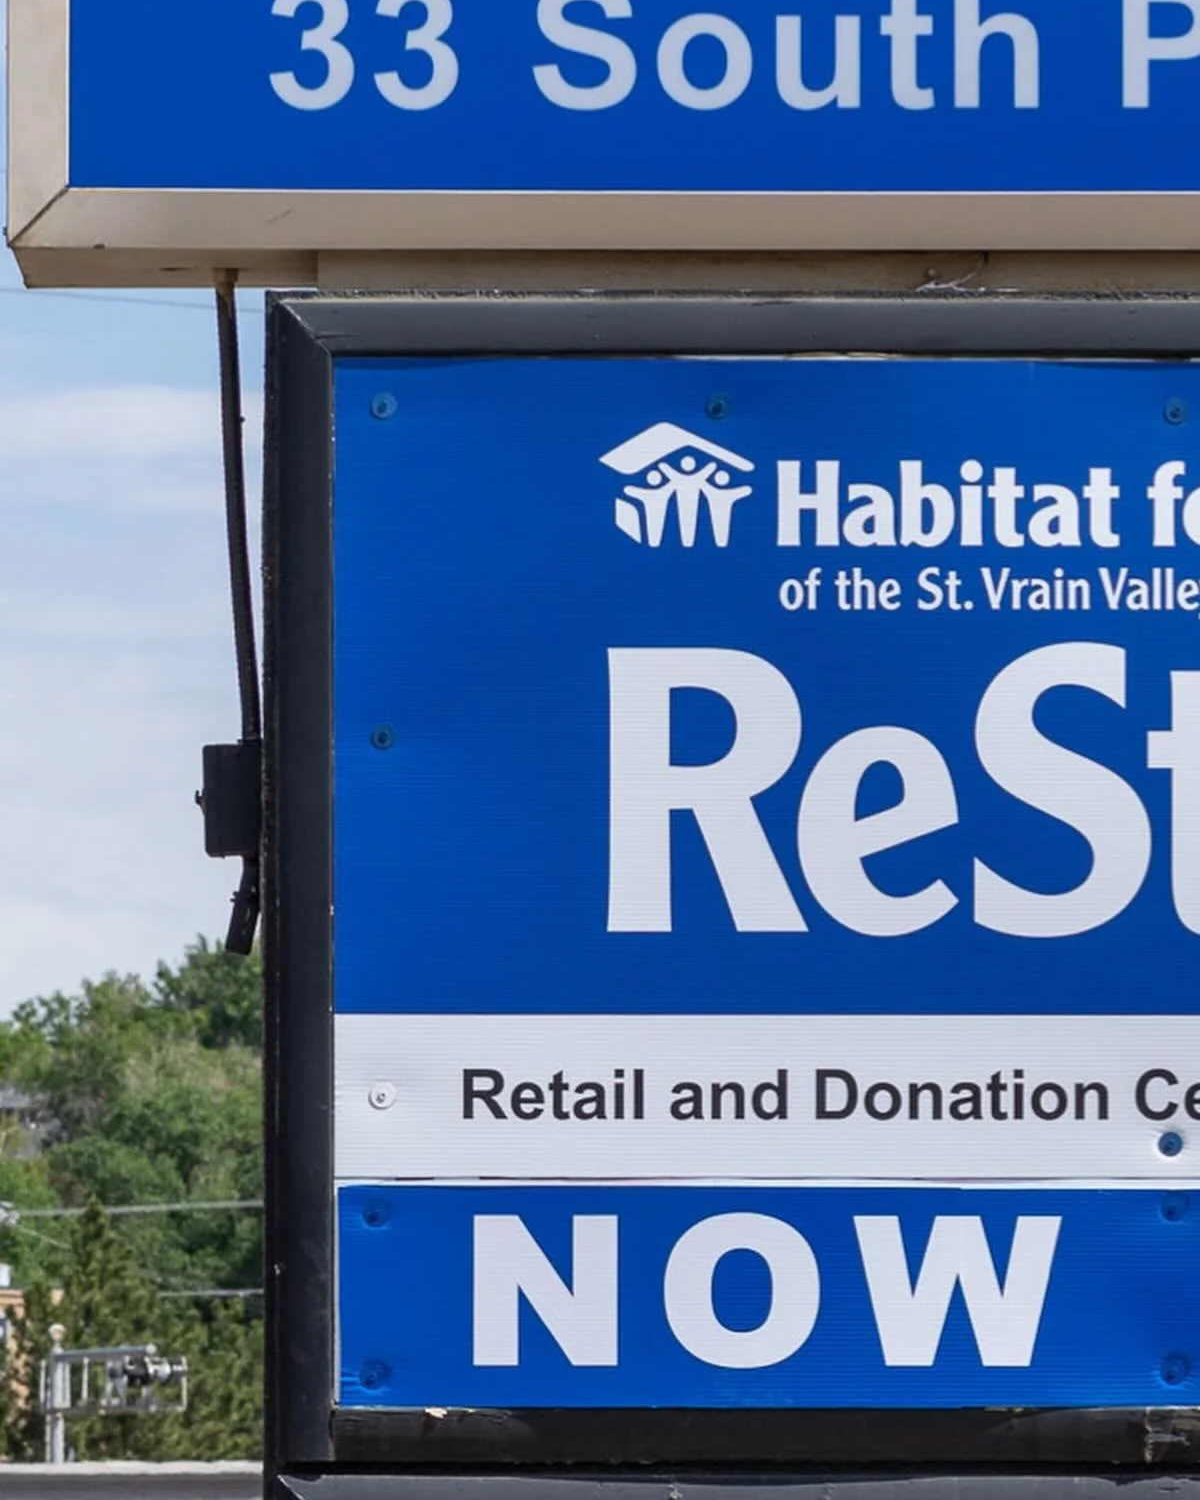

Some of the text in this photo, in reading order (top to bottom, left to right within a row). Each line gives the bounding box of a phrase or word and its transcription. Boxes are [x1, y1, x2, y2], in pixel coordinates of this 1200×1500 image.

[777, 459, 1120, 548] Habitat
[779, 567, 821, 611] of
[834, 567, 901, 611] the
[917, 566, 974, 611] St.
[980, 567, 1091, 611] Vrain
[462, 1068, 645, 1121] Retail
[670, 1068, 788, 1121] and
[815, 1068, 1109, 1121] Donation
[473, 1212, 1062, 1369] NOW
